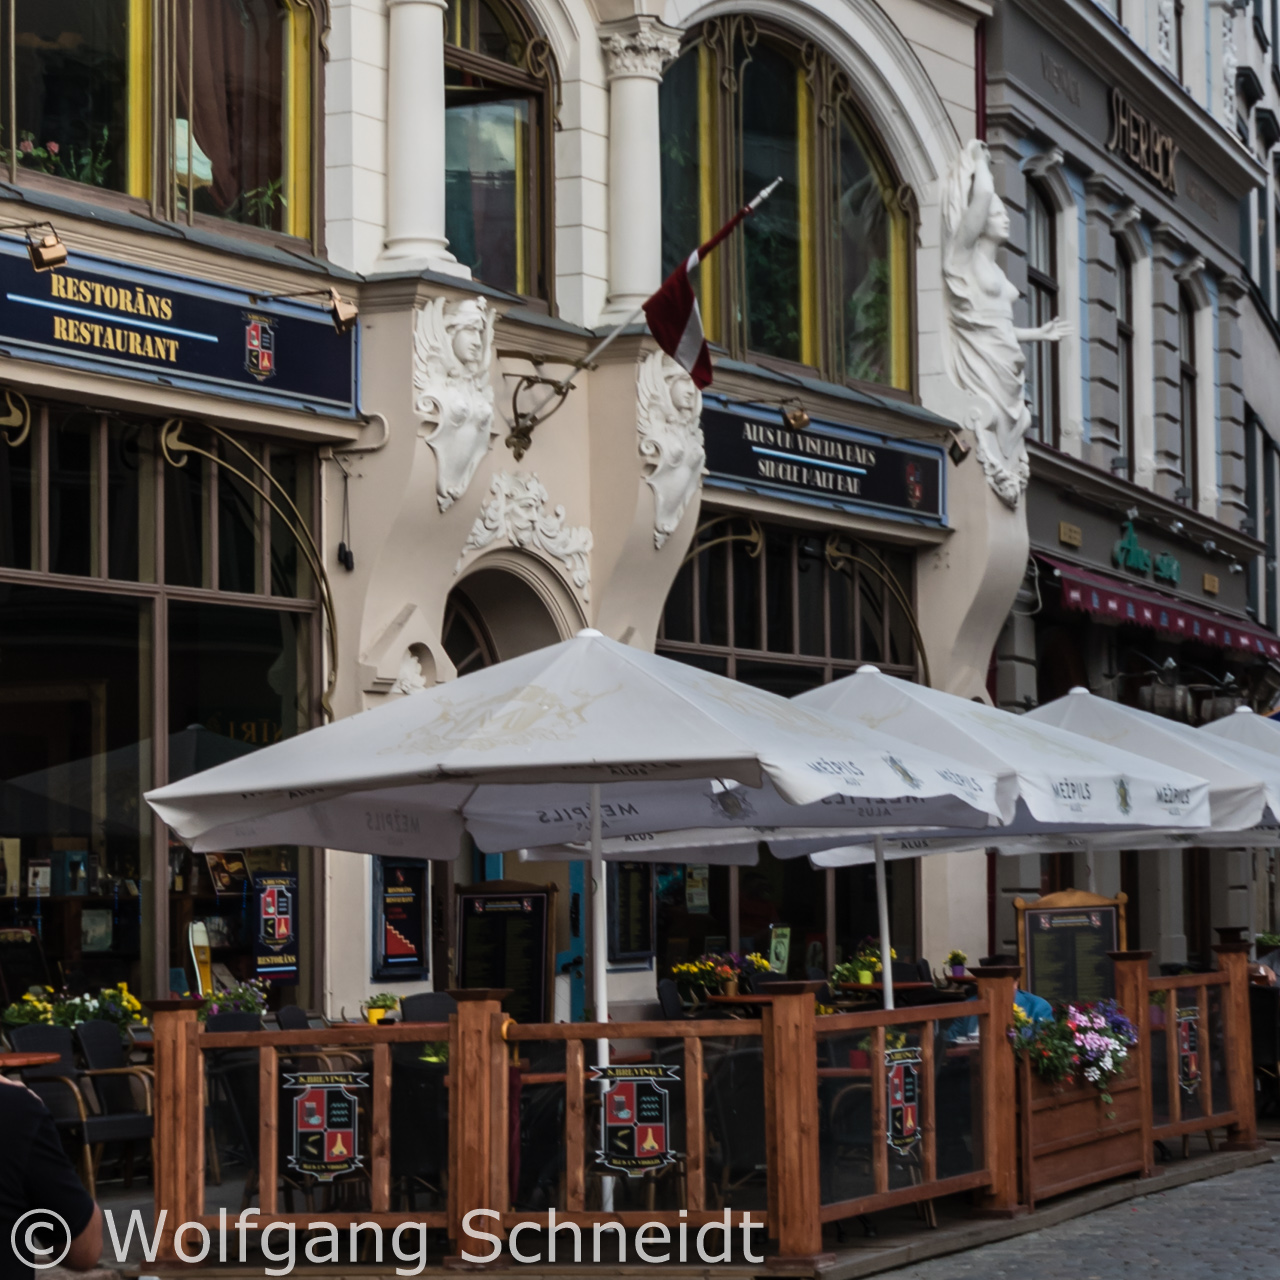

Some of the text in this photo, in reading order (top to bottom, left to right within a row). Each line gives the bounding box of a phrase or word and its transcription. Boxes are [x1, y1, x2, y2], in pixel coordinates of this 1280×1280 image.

[51, 272, 173, 320] RESTORĀNS
[53, 316, 179, 362] RESTAURANT
[742, 422, 776, 446] ALUS
[757, 458, 862, 496] SINGLE MALT BAR
[1051, 777, 1093, 801] MEŽPILS
[901, 838, 930, 850] ALUS
